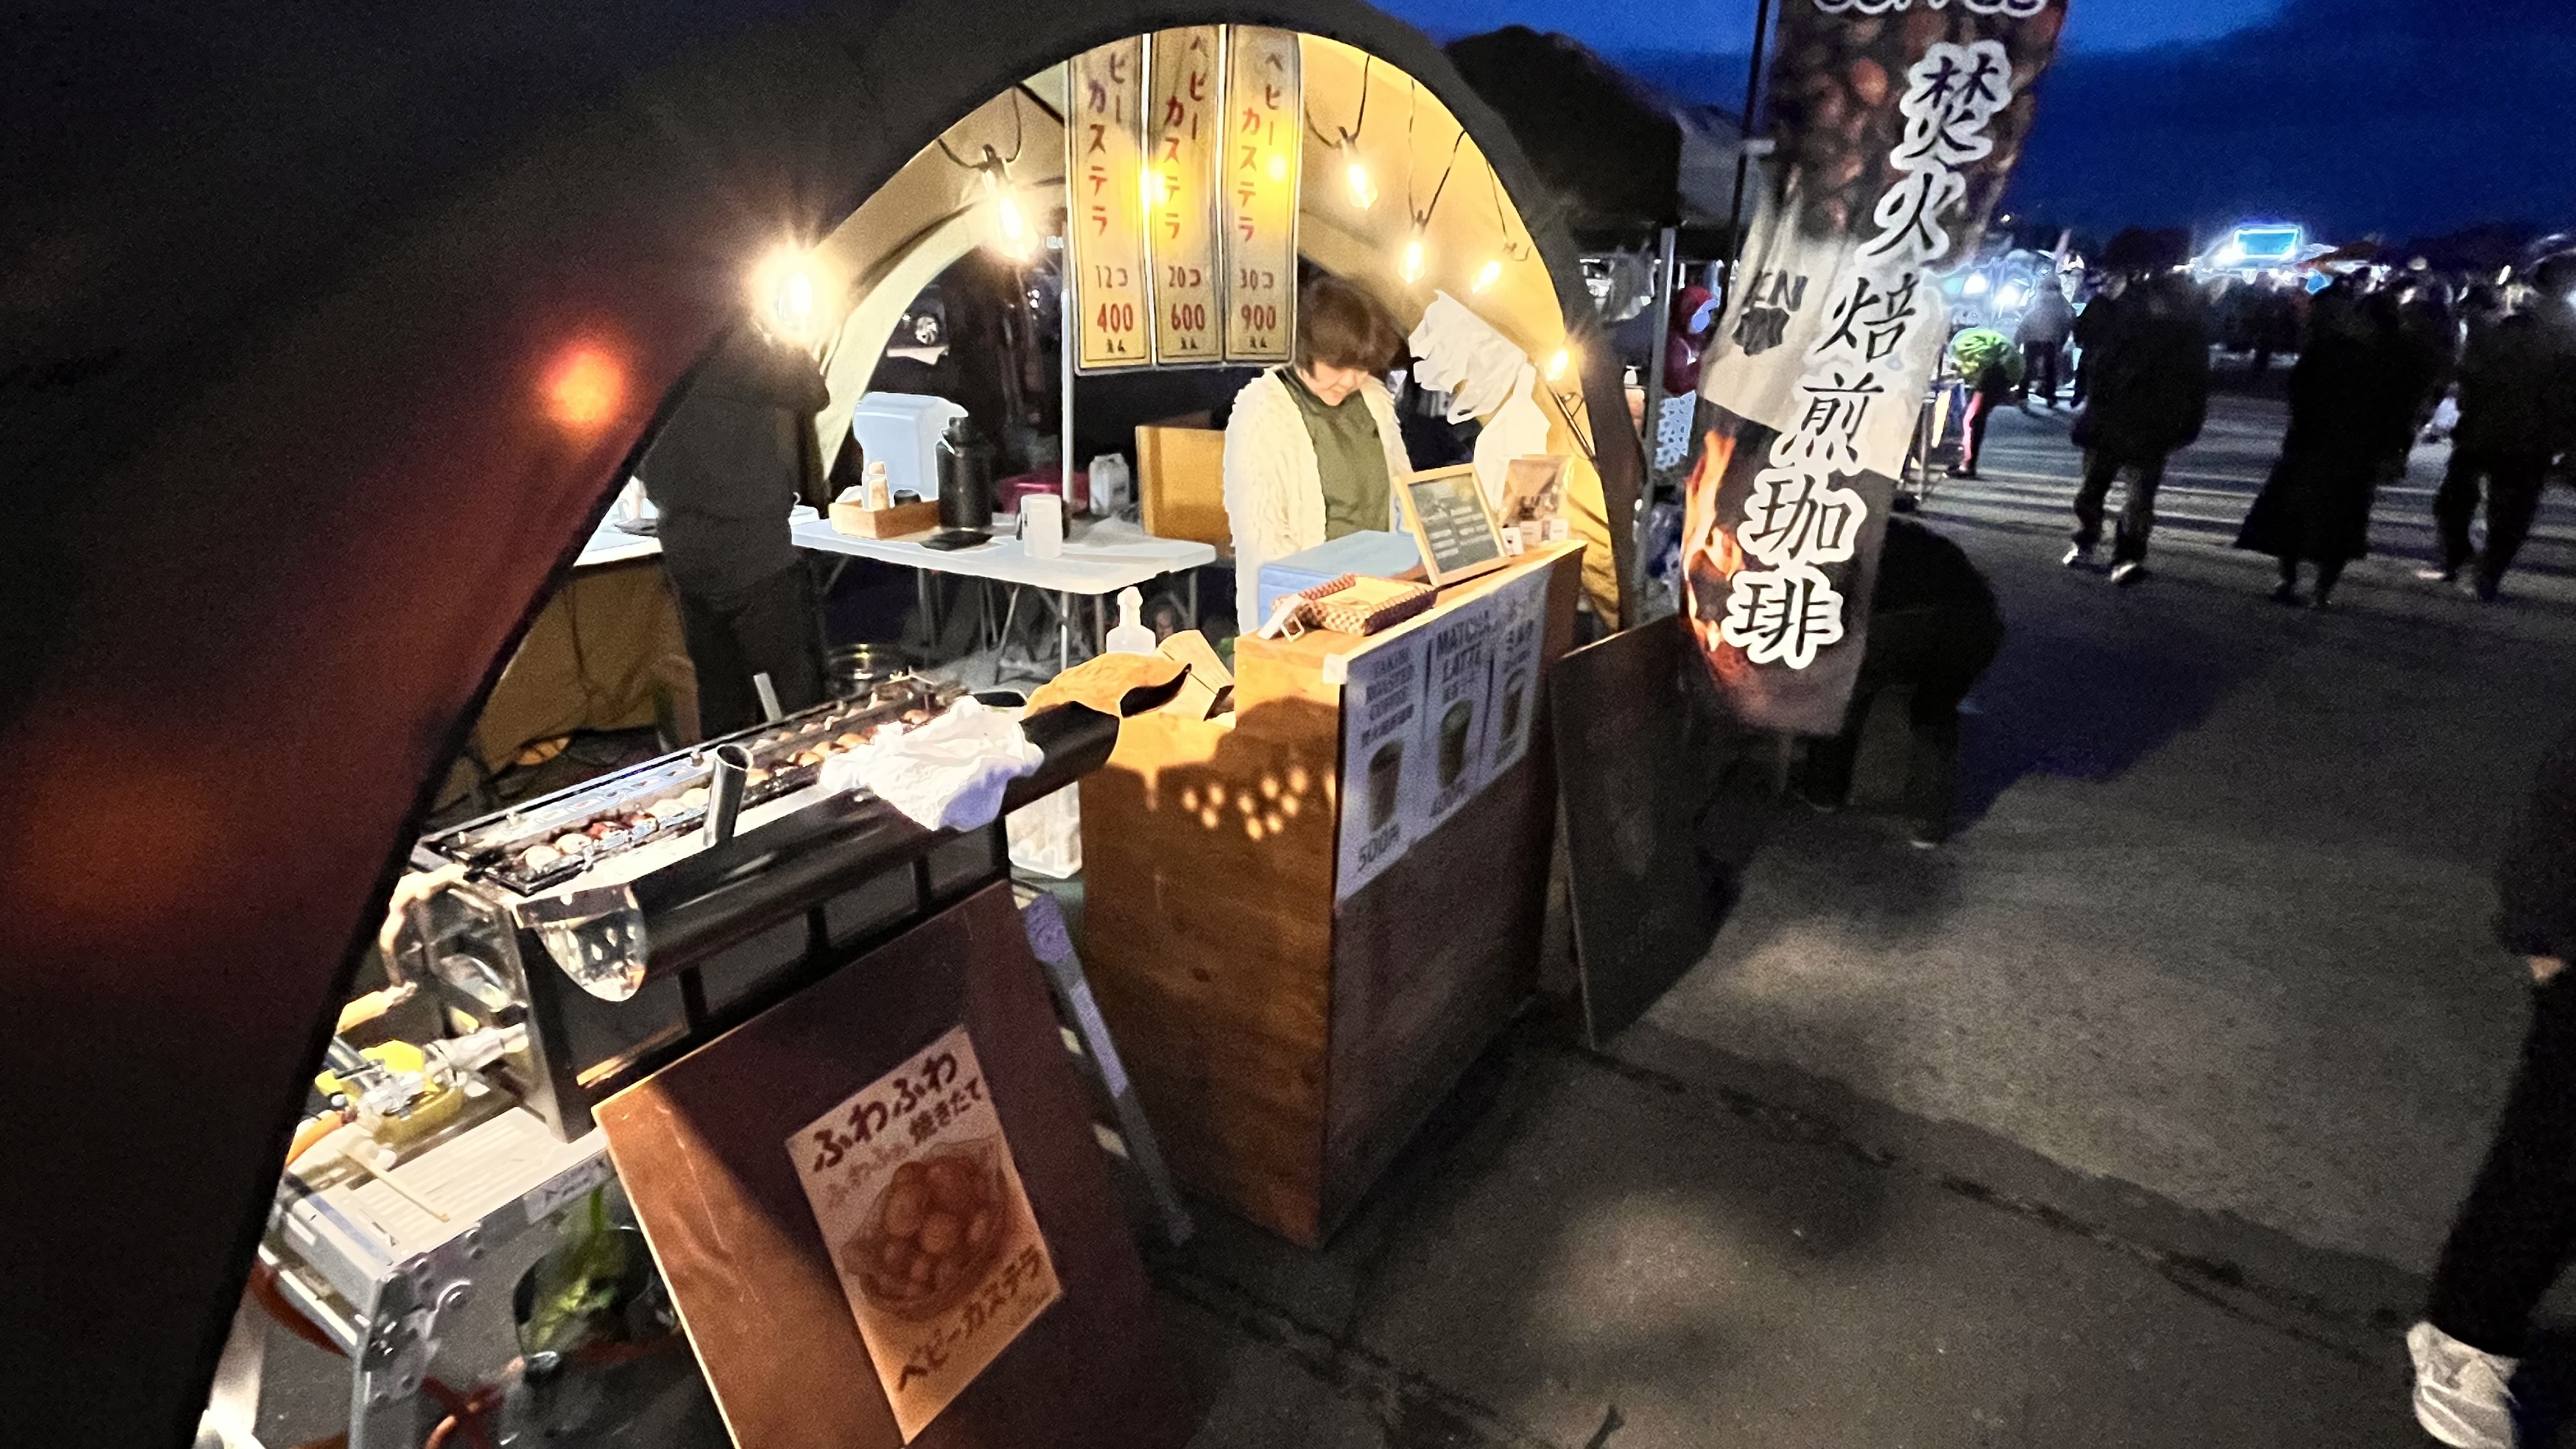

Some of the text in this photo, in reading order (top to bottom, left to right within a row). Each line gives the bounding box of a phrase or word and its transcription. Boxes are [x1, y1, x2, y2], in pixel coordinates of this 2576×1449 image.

[1087, 79, 1108, 237] カステラ
[1163, 95, 1184, 240] カステラ
[1238, 107, 1261, 242] カステラ
[1096, 302, 1133, 334] 400
[1170, 302, 1205, 331] 600
[1240, 303, 1276, 332] 900
[1728, 46, 2004, 663] 焚火焙煎珈琲
[813, 1052, 958, 1172] ふわふわ
[908, 1077, 982, 1147] 焼きたて
[897, 1245, 1041, 1393] ベビーカステラ
